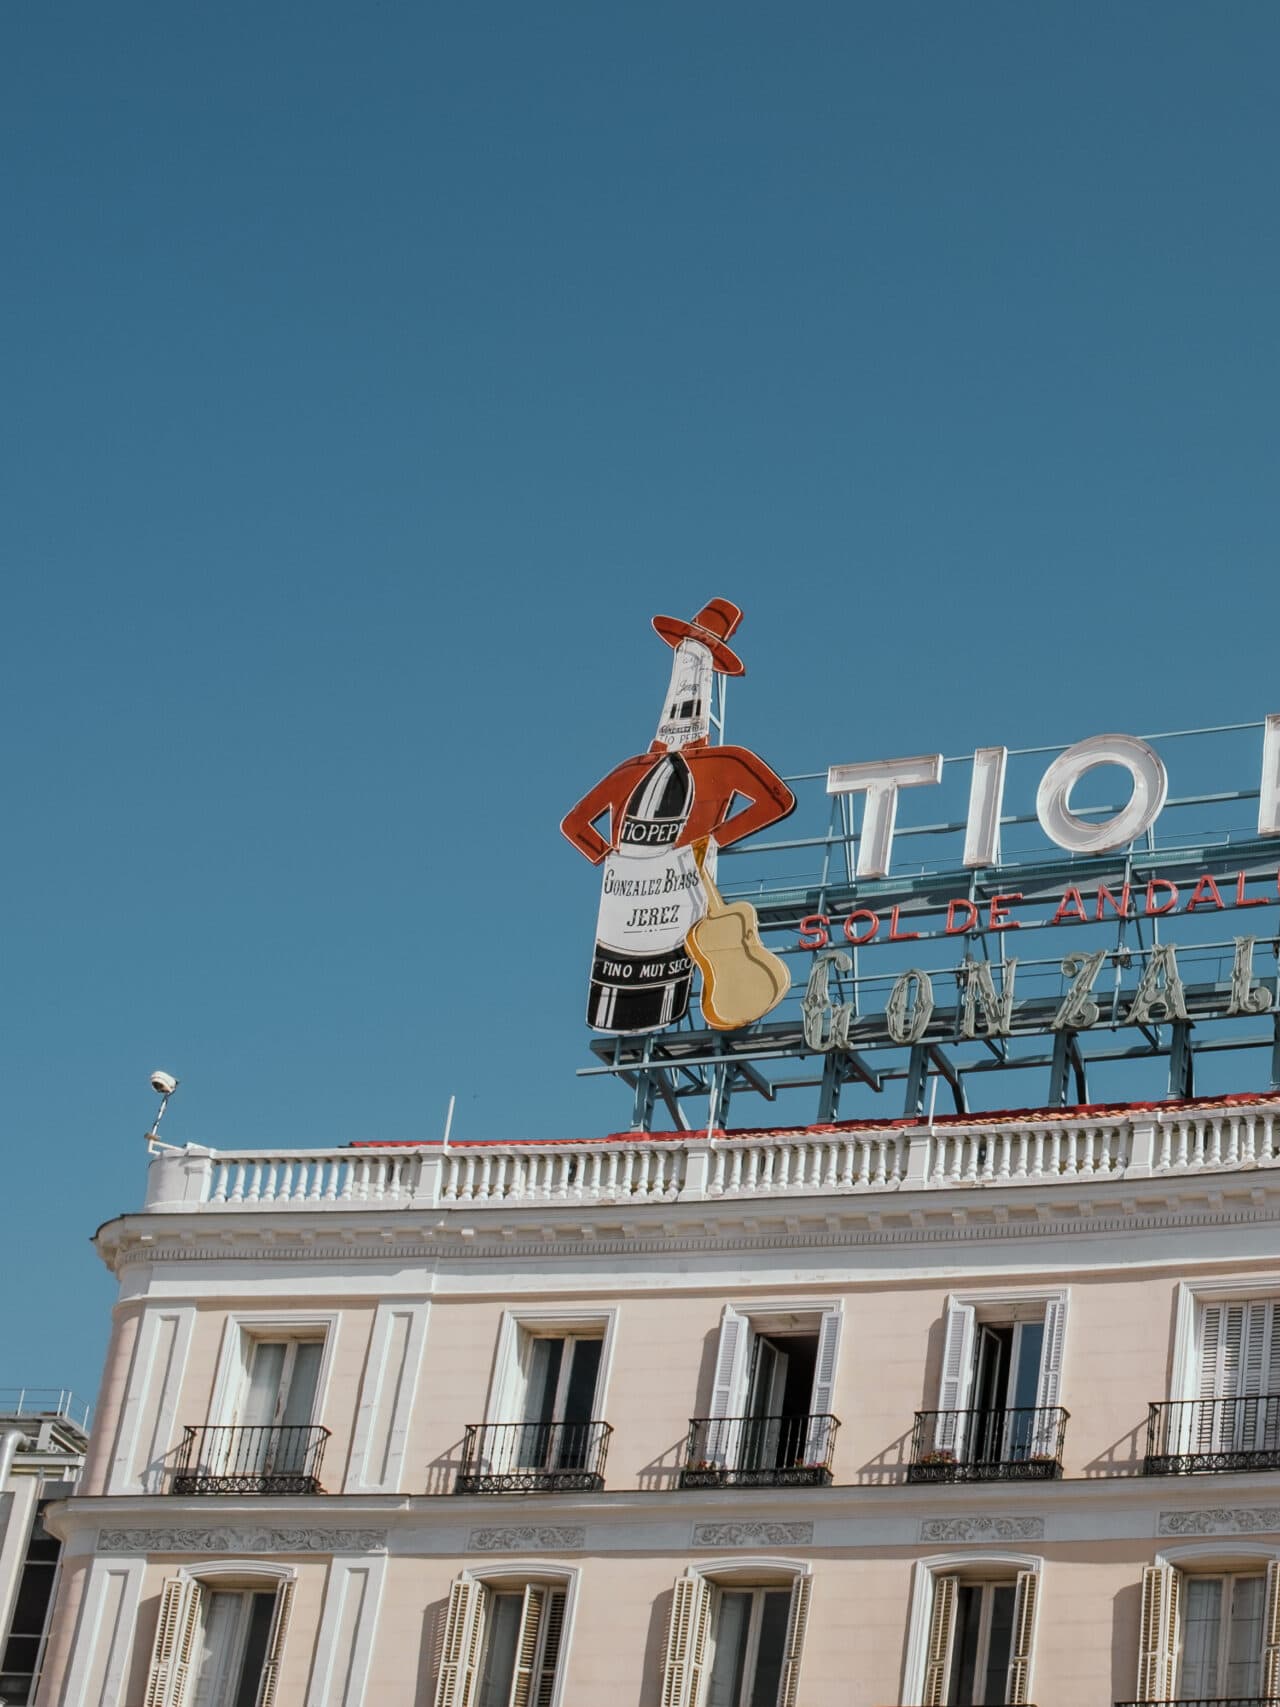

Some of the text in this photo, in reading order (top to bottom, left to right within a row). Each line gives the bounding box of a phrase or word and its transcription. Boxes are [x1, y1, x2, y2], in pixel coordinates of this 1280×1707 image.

[826, 733, 1168, 880] TIO
[604, 868, 662, 897] GONZALEZ
[626, 904, 680, 927] JEREZ
[798, 905, 920, 951] SOL
[945, 892, 1024, 935] DE
[602, 957, 692, 979] FINO MUY SECO
